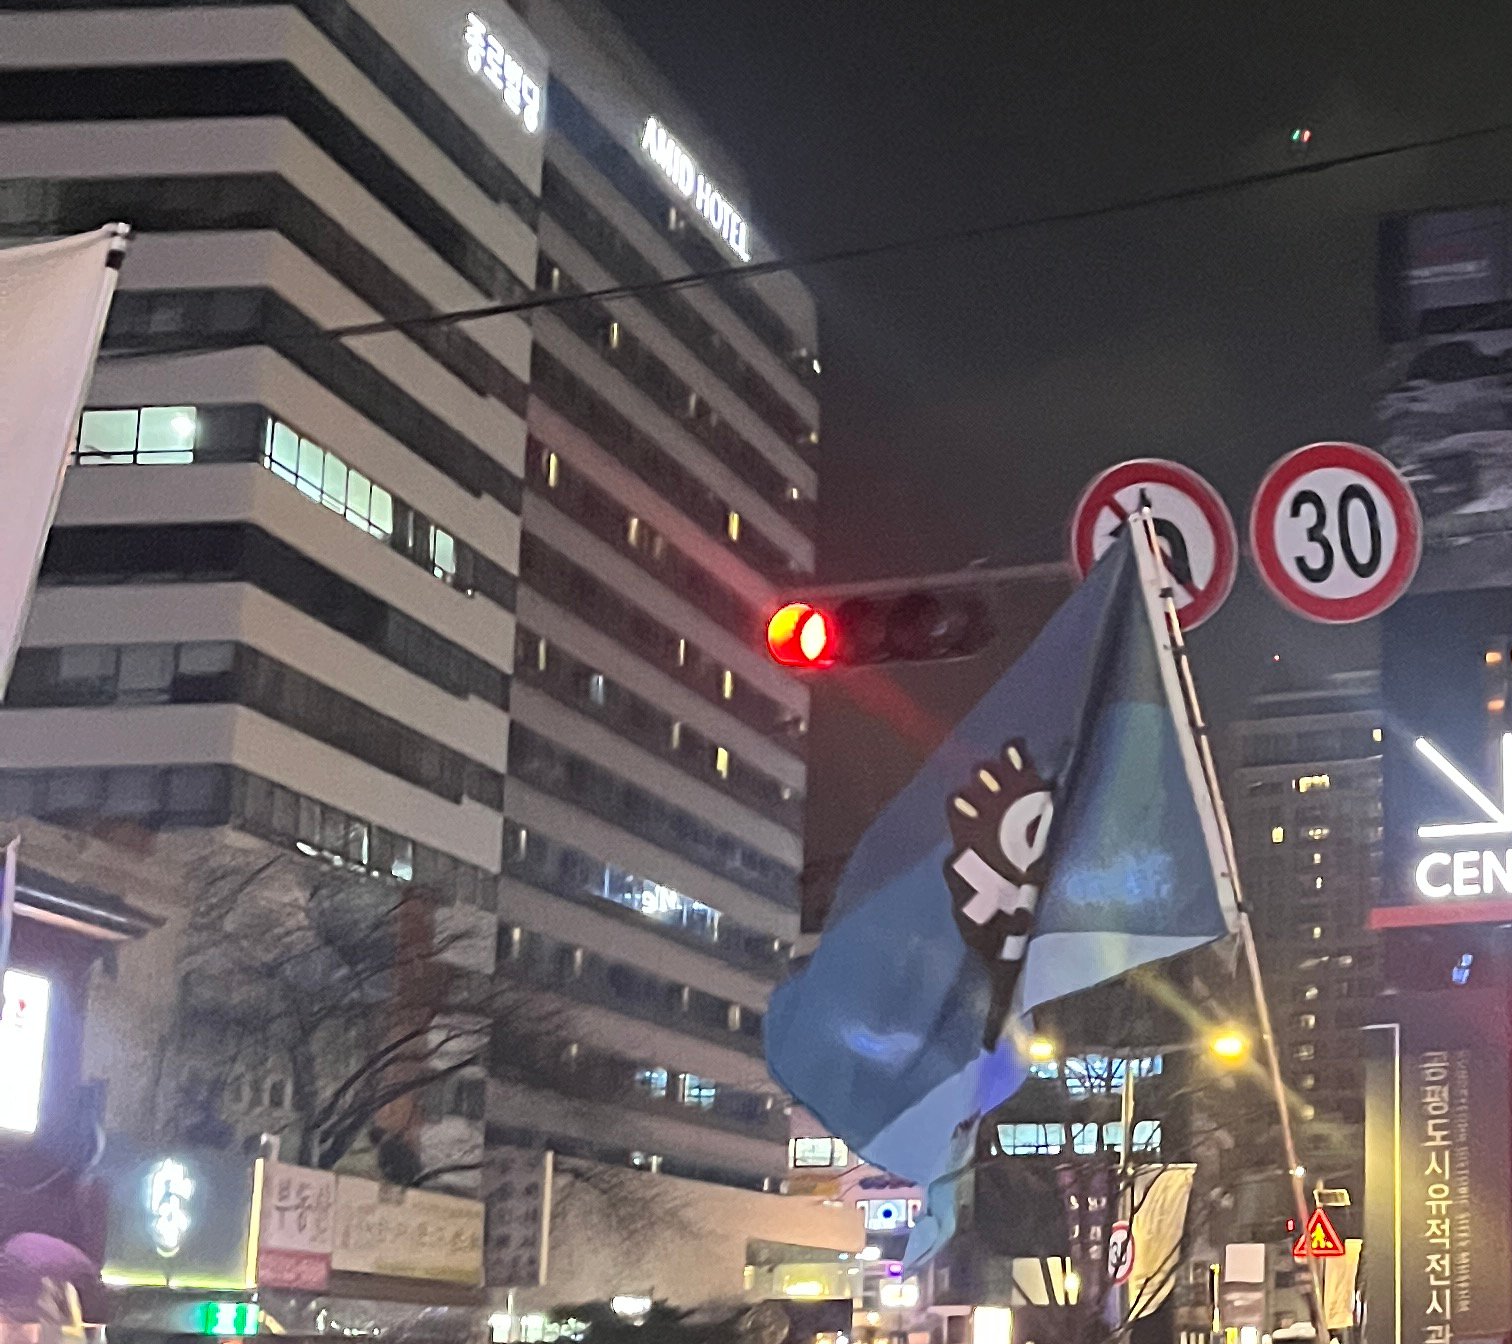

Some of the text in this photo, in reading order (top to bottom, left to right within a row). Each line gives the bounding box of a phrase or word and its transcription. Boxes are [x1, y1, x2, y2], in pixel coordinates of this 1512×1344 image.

[641, 116, 751, 263] AMID HOTEL
[1290, 484, 1382, 583] 30
